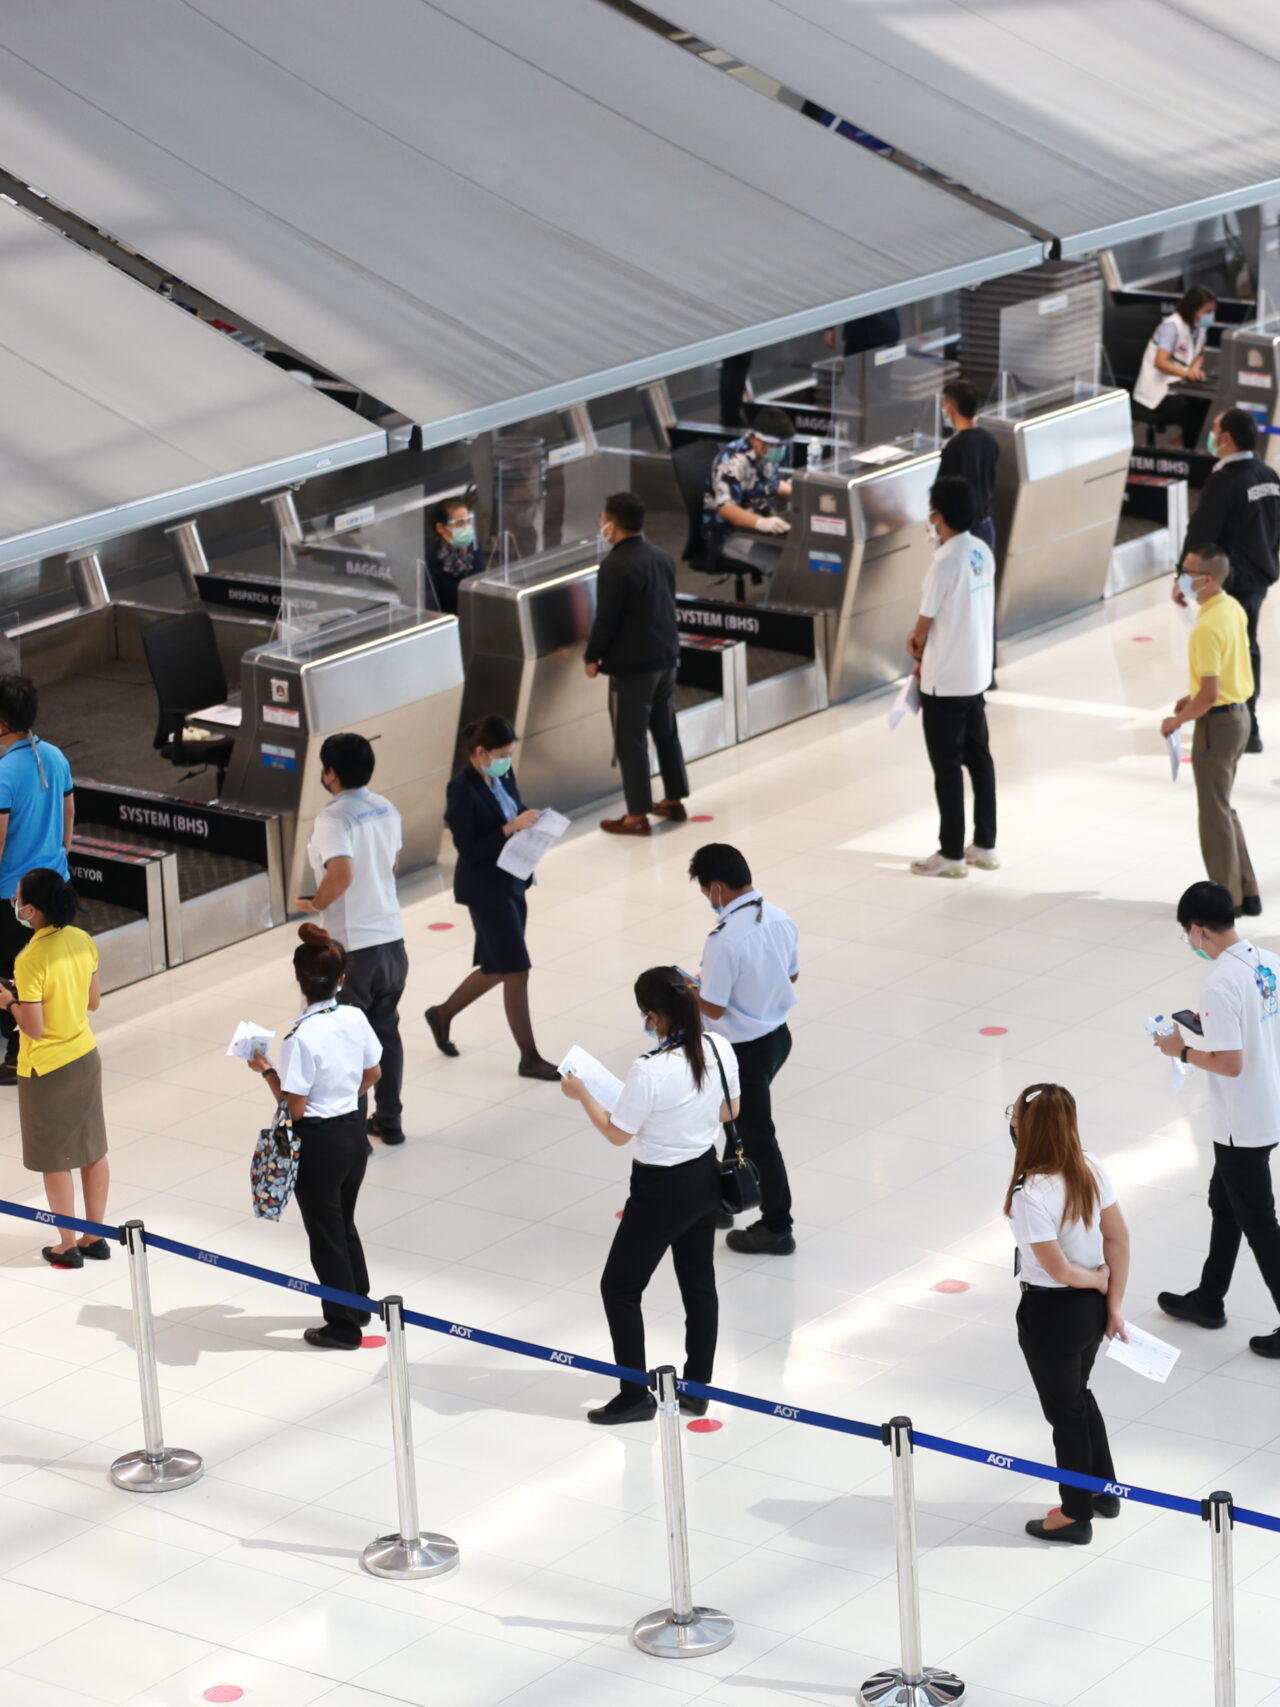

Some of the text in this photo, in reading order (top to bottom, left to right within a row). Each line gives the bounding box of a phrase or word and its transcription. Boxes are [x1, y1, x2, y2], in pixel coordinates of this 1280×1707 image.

[1157, 459, 1189, 475] (BHS)
[228, 589, 269, 604] DISPATCH
[725, 612, 760, 635] (BHS)
[119, 804, 209, 838] SYSTEM (BHS)
[35, 1210, 57, 1225] AOT
[198, 1251, 220, 1266] AOT
[287, 1278, 309, 1293] AOT
[449, 1324, 474, 1339] AOT
[550, 1351, 575, 1366] AOT
[773, 1404, 800, 1420] AOT
[986, 1453, 1014, 1469] AOT
[1103, 1482, 1132, 1498] AOT
